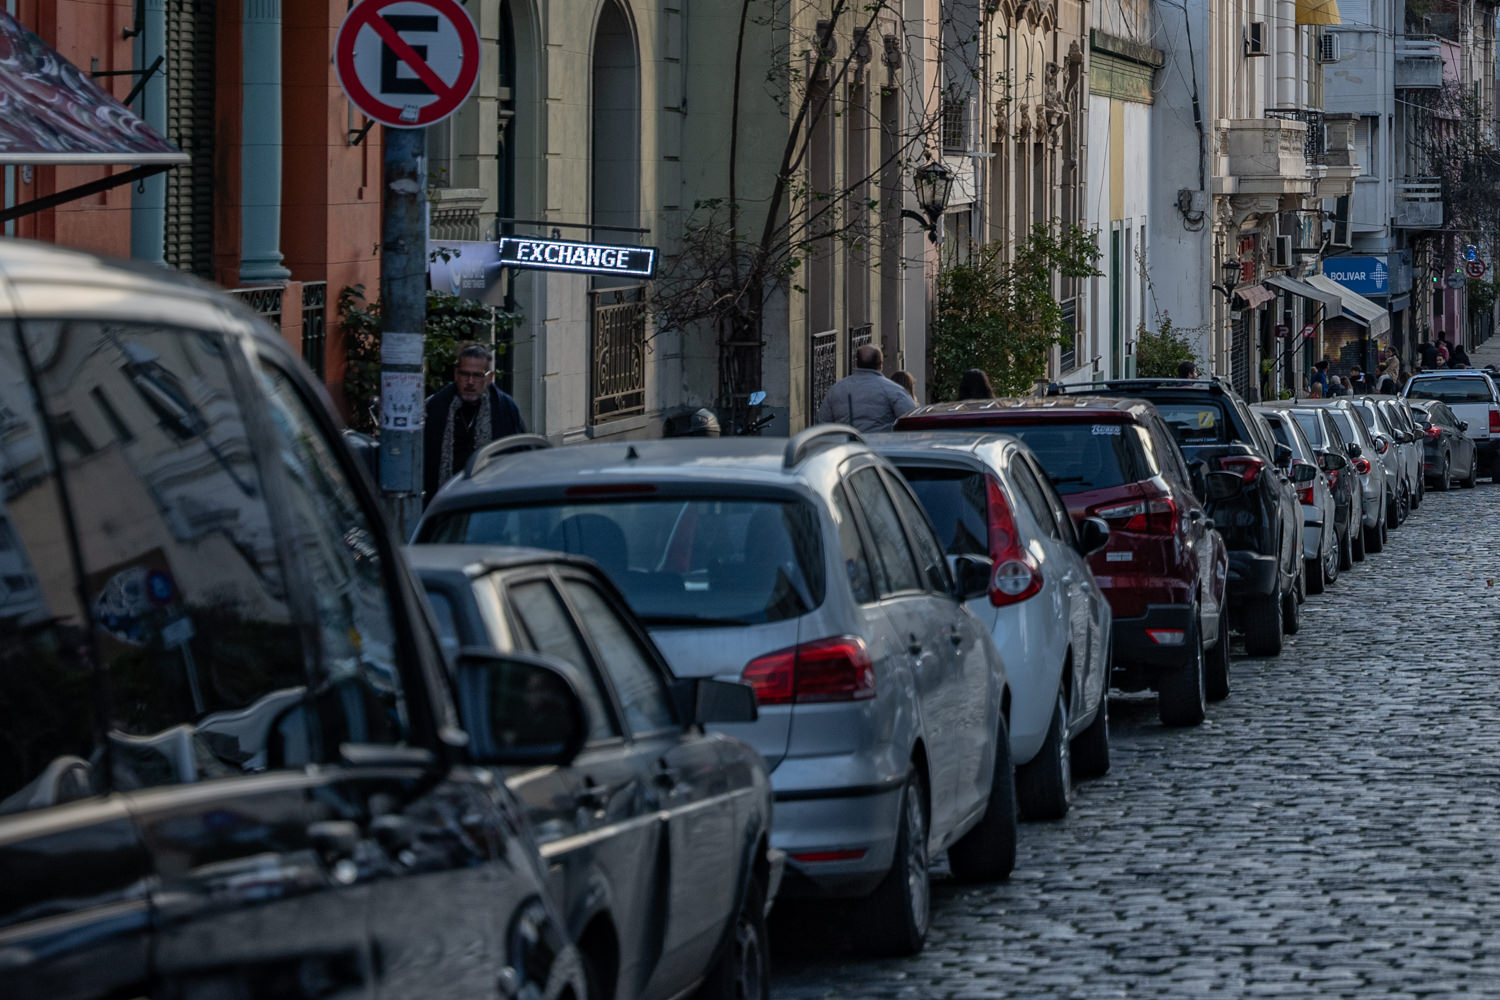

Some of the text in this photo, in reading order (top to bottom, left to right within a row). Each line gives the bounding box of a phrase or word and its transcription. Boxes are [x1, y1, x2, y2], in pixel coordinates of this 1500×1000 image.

[381, 15, 439, 94] E
[516, 242, 630, 269] EXCHANGE
[1330, 271, 1366, 281] BOLIVAR
